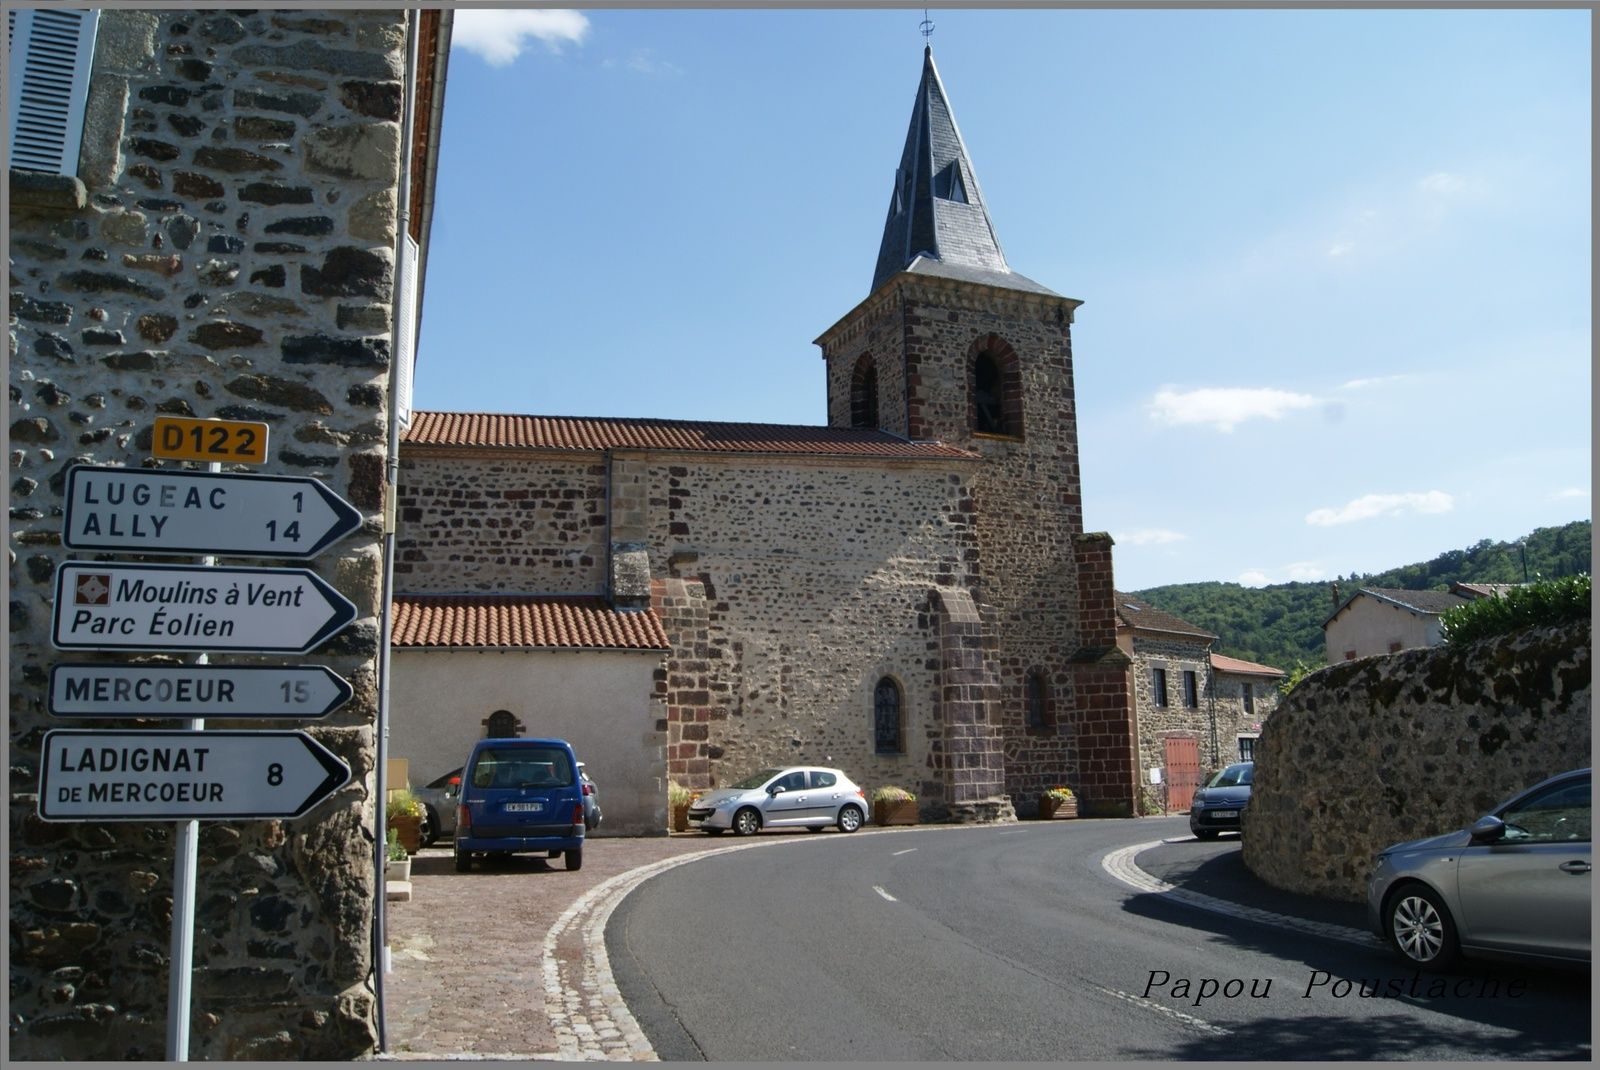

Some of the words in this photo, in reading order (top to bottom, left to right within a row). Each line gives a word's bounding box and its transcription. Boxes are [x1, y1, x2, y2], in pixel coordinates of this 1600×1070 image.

[161, 425, 256, 456] D122
[84, 481, 227, 510] LUGEAC
[292, 491, 304, 513] 1
[83, 513, 169, 538] ALLY
[266, 520, 301, 542] 14
[116, 579, 217, 605] Moulins
[224, 582, 240, 605] à
[247, 584, 304, 607] Vent
[71, 609, 135, 634] Parc
[149, 607, 234, 637] Éolien
[65, 677, 235, 703] MERCOEUR
[280, 680, 310, 703] 15
[60, 748, 210, 772] LADIGNAT
[267, 763, 284, 786] 8
[58, 787, 82, 803] DE
[88, 782, 224, 803] MERCOEUR
